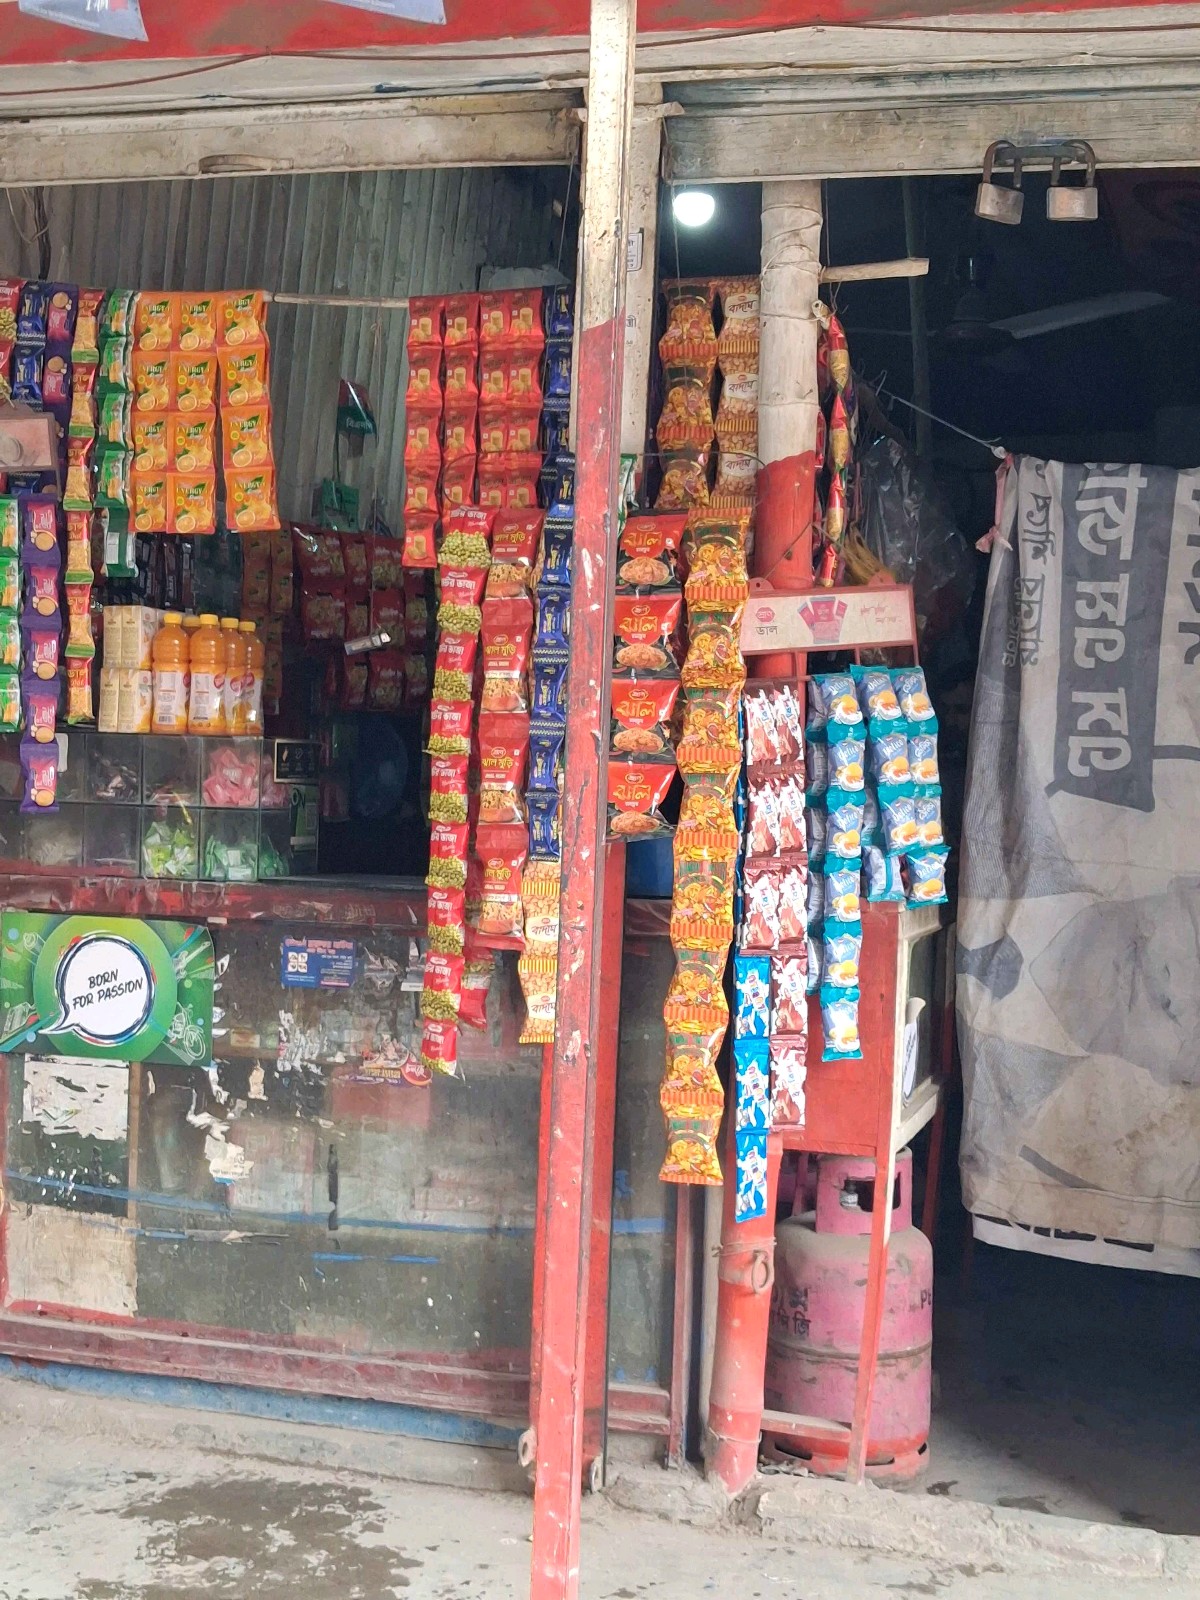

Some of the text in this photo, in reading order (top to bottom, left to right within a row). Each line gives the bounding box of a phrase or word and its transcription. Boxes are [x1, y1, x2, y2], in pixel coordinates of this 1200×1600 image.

[756, 625, 778, 636] ডাল
[88, 968, 119, 989] BORN
[72, 977, 144, 1010] FOR PASSION
